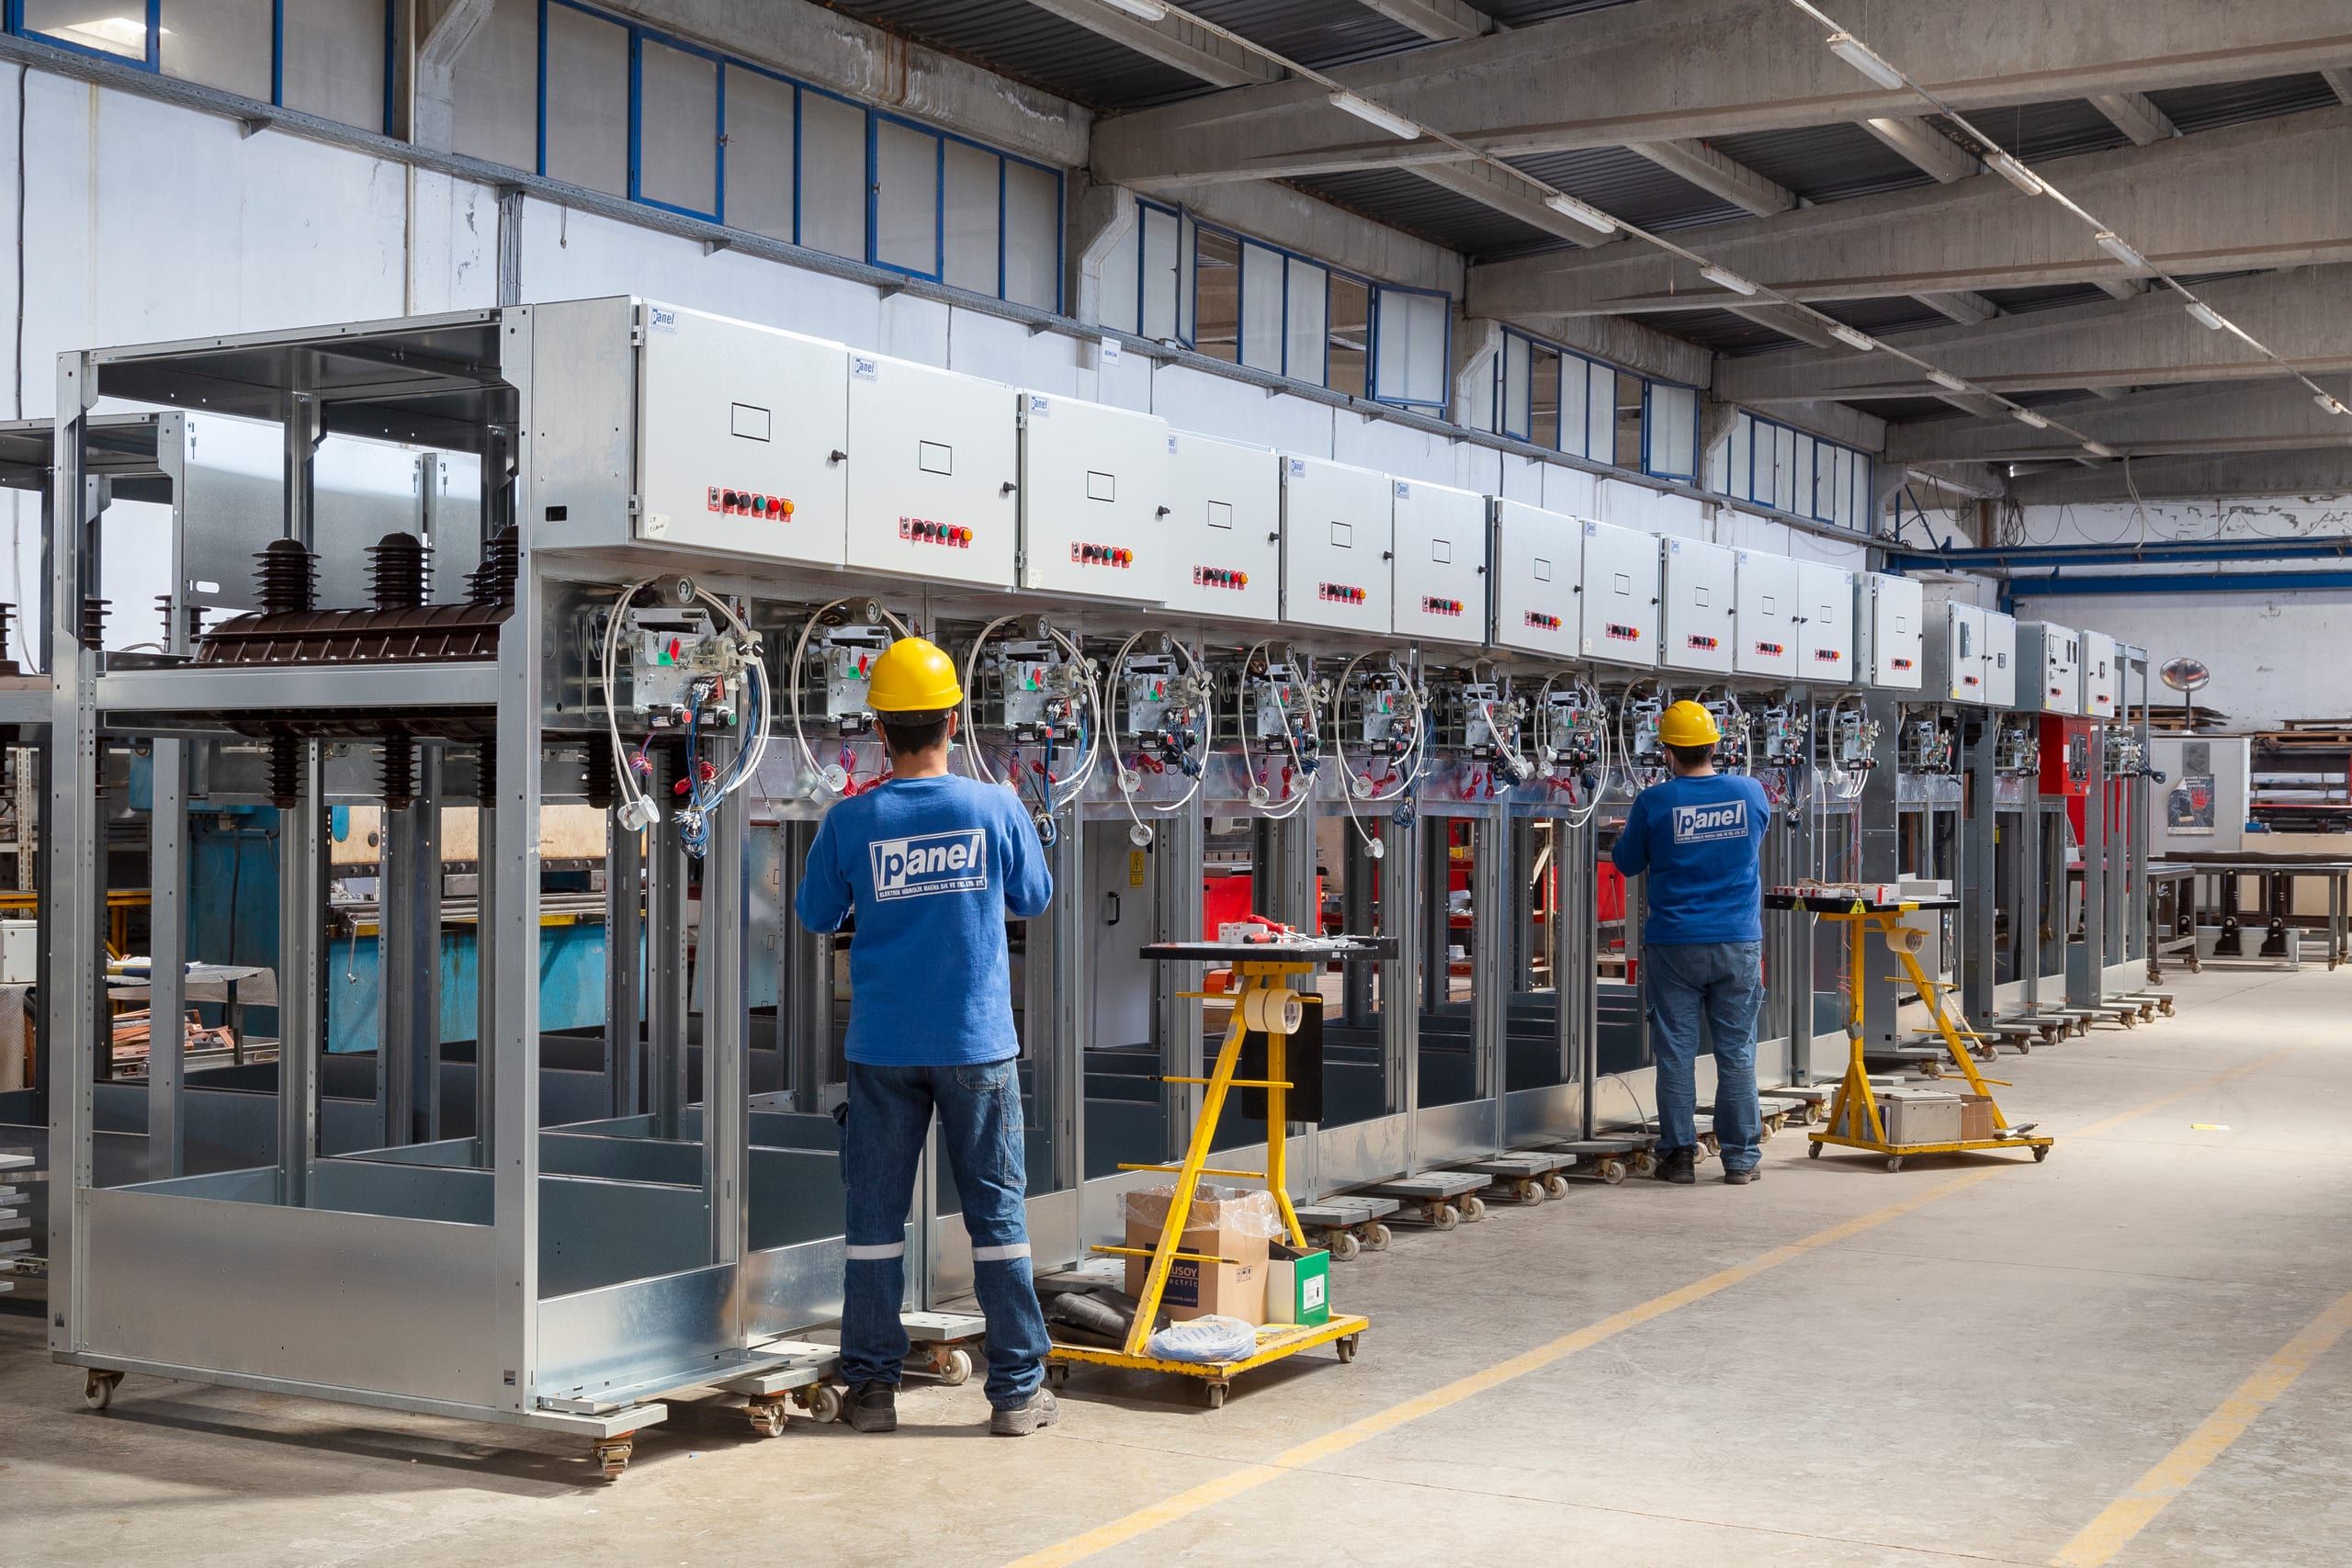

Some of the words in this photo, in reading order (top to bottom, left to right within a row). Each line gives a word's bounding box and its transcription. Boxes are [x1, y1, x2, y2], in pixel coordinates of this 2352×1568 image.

[651, 308, 675, 325] panel
[854, 358, 875, 374] panel
[1679, 803, 1743, 835] panel
[882, 834, 981, 887] panel
[1170, 1266, 1198, 1277] USOY
[1169, 1278, 1198, 1288] ectric
